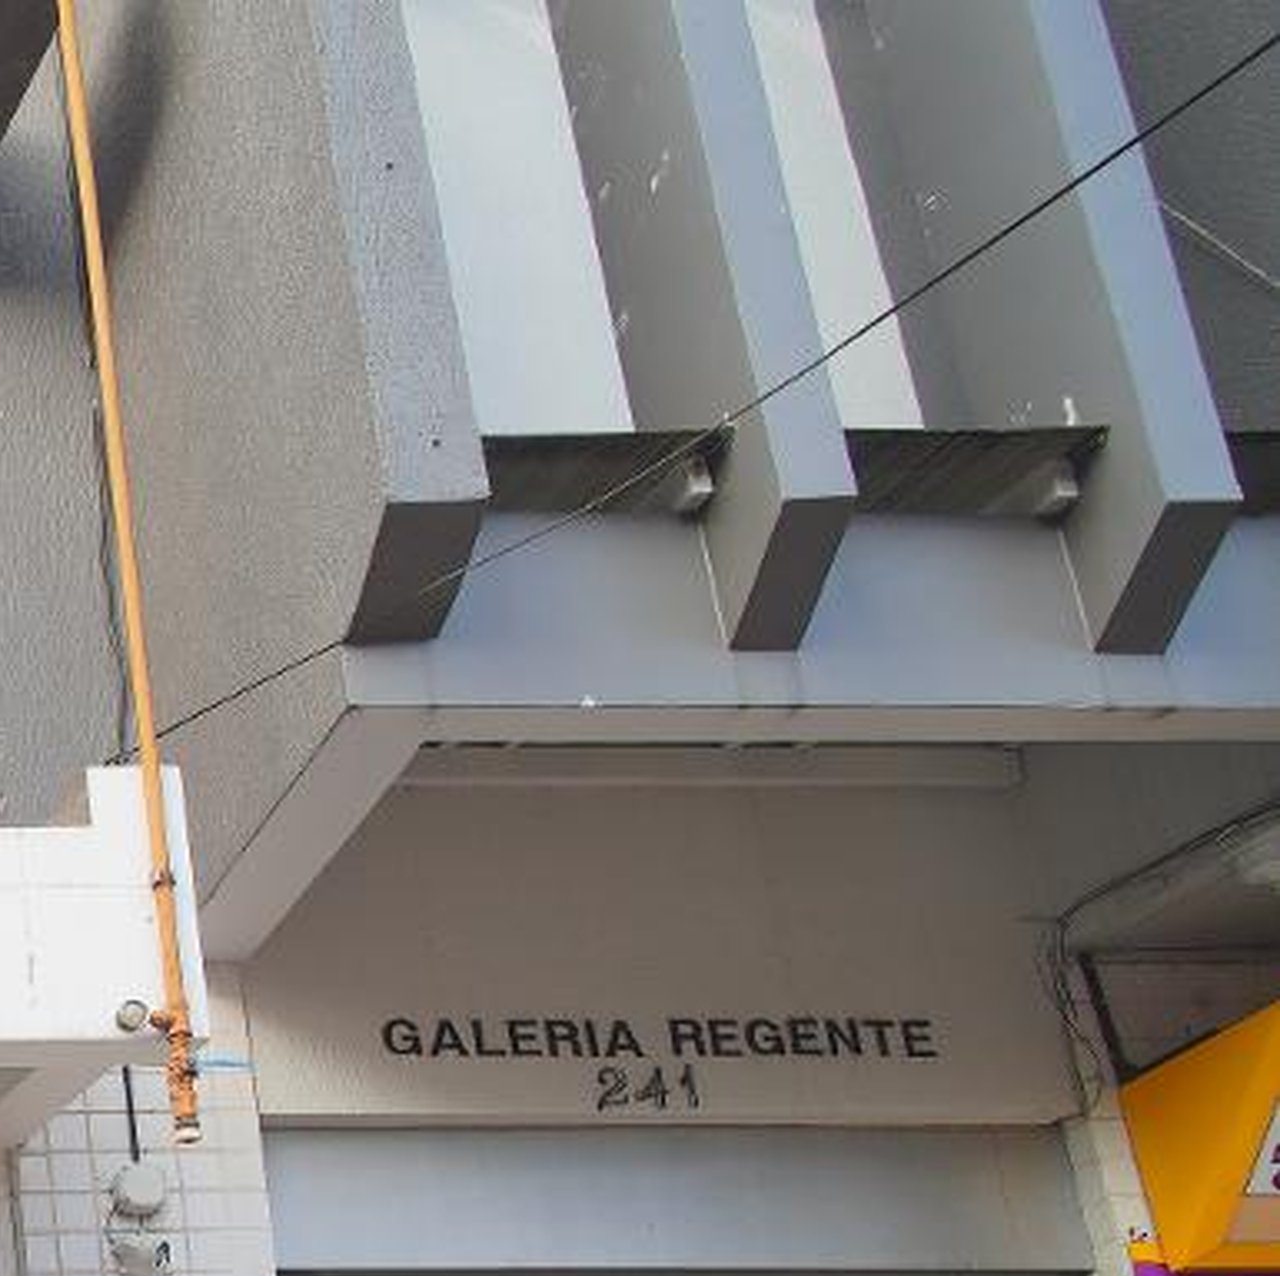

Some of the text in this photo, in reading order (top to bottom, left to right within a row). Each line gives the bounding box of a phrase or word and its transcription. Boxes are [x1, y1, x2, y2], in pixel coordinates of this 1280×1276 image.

[380, 1017, 939, 1059] GALERIA REGENTE
[595, 1063, 701, 1112] 241
